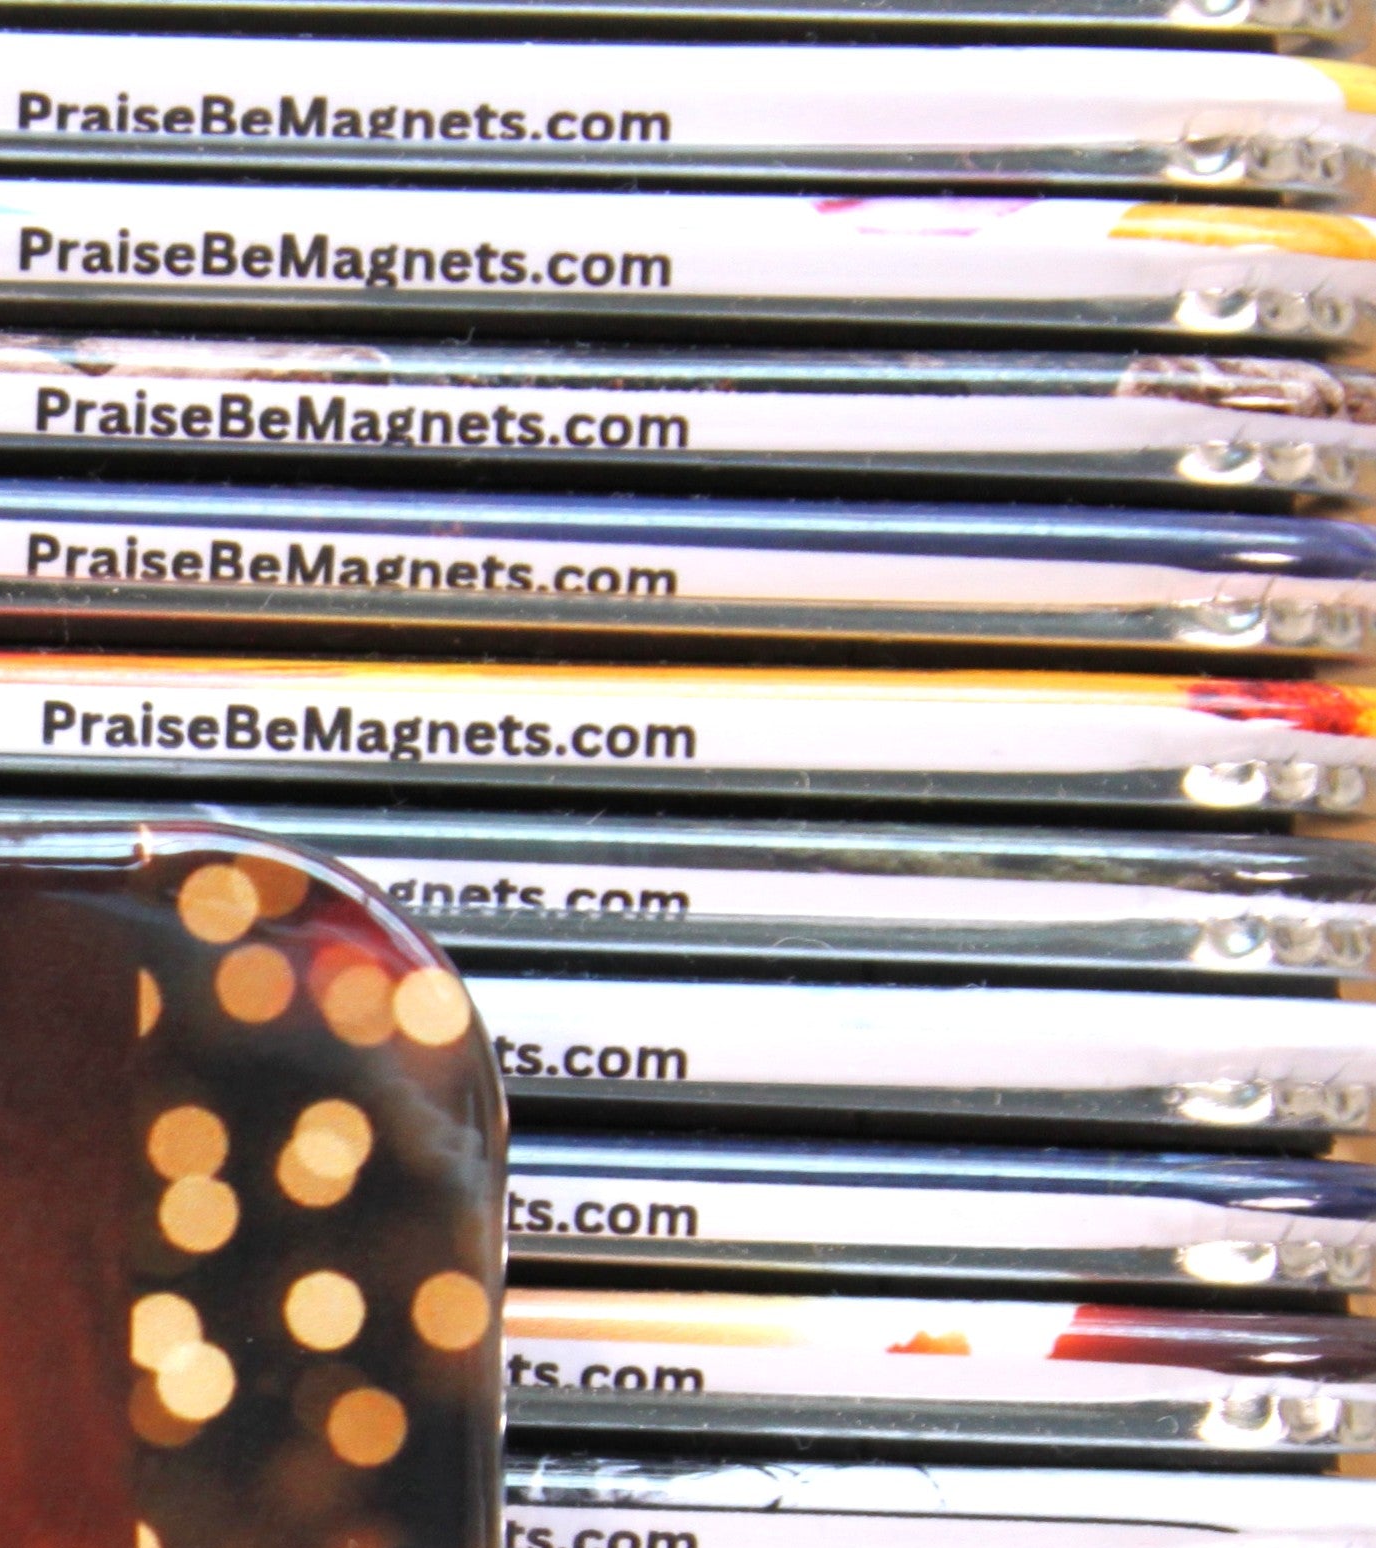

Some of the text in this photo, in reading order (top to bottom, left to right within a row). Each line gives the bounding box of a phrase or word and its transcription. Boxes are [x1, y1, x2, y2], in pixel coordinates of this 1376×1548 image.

[16, 91, 672, 142] PraiseBeMagnets.com
[18, 226, 672, 289] PraiseBeMagnets.com
[35, 388, 689, 448] PraiseBeMagnets.com
[26, 532, 677, 597] PraiseBeMagnets.com
[42, 700, 697, 763] PraiseBeMagnets.com
